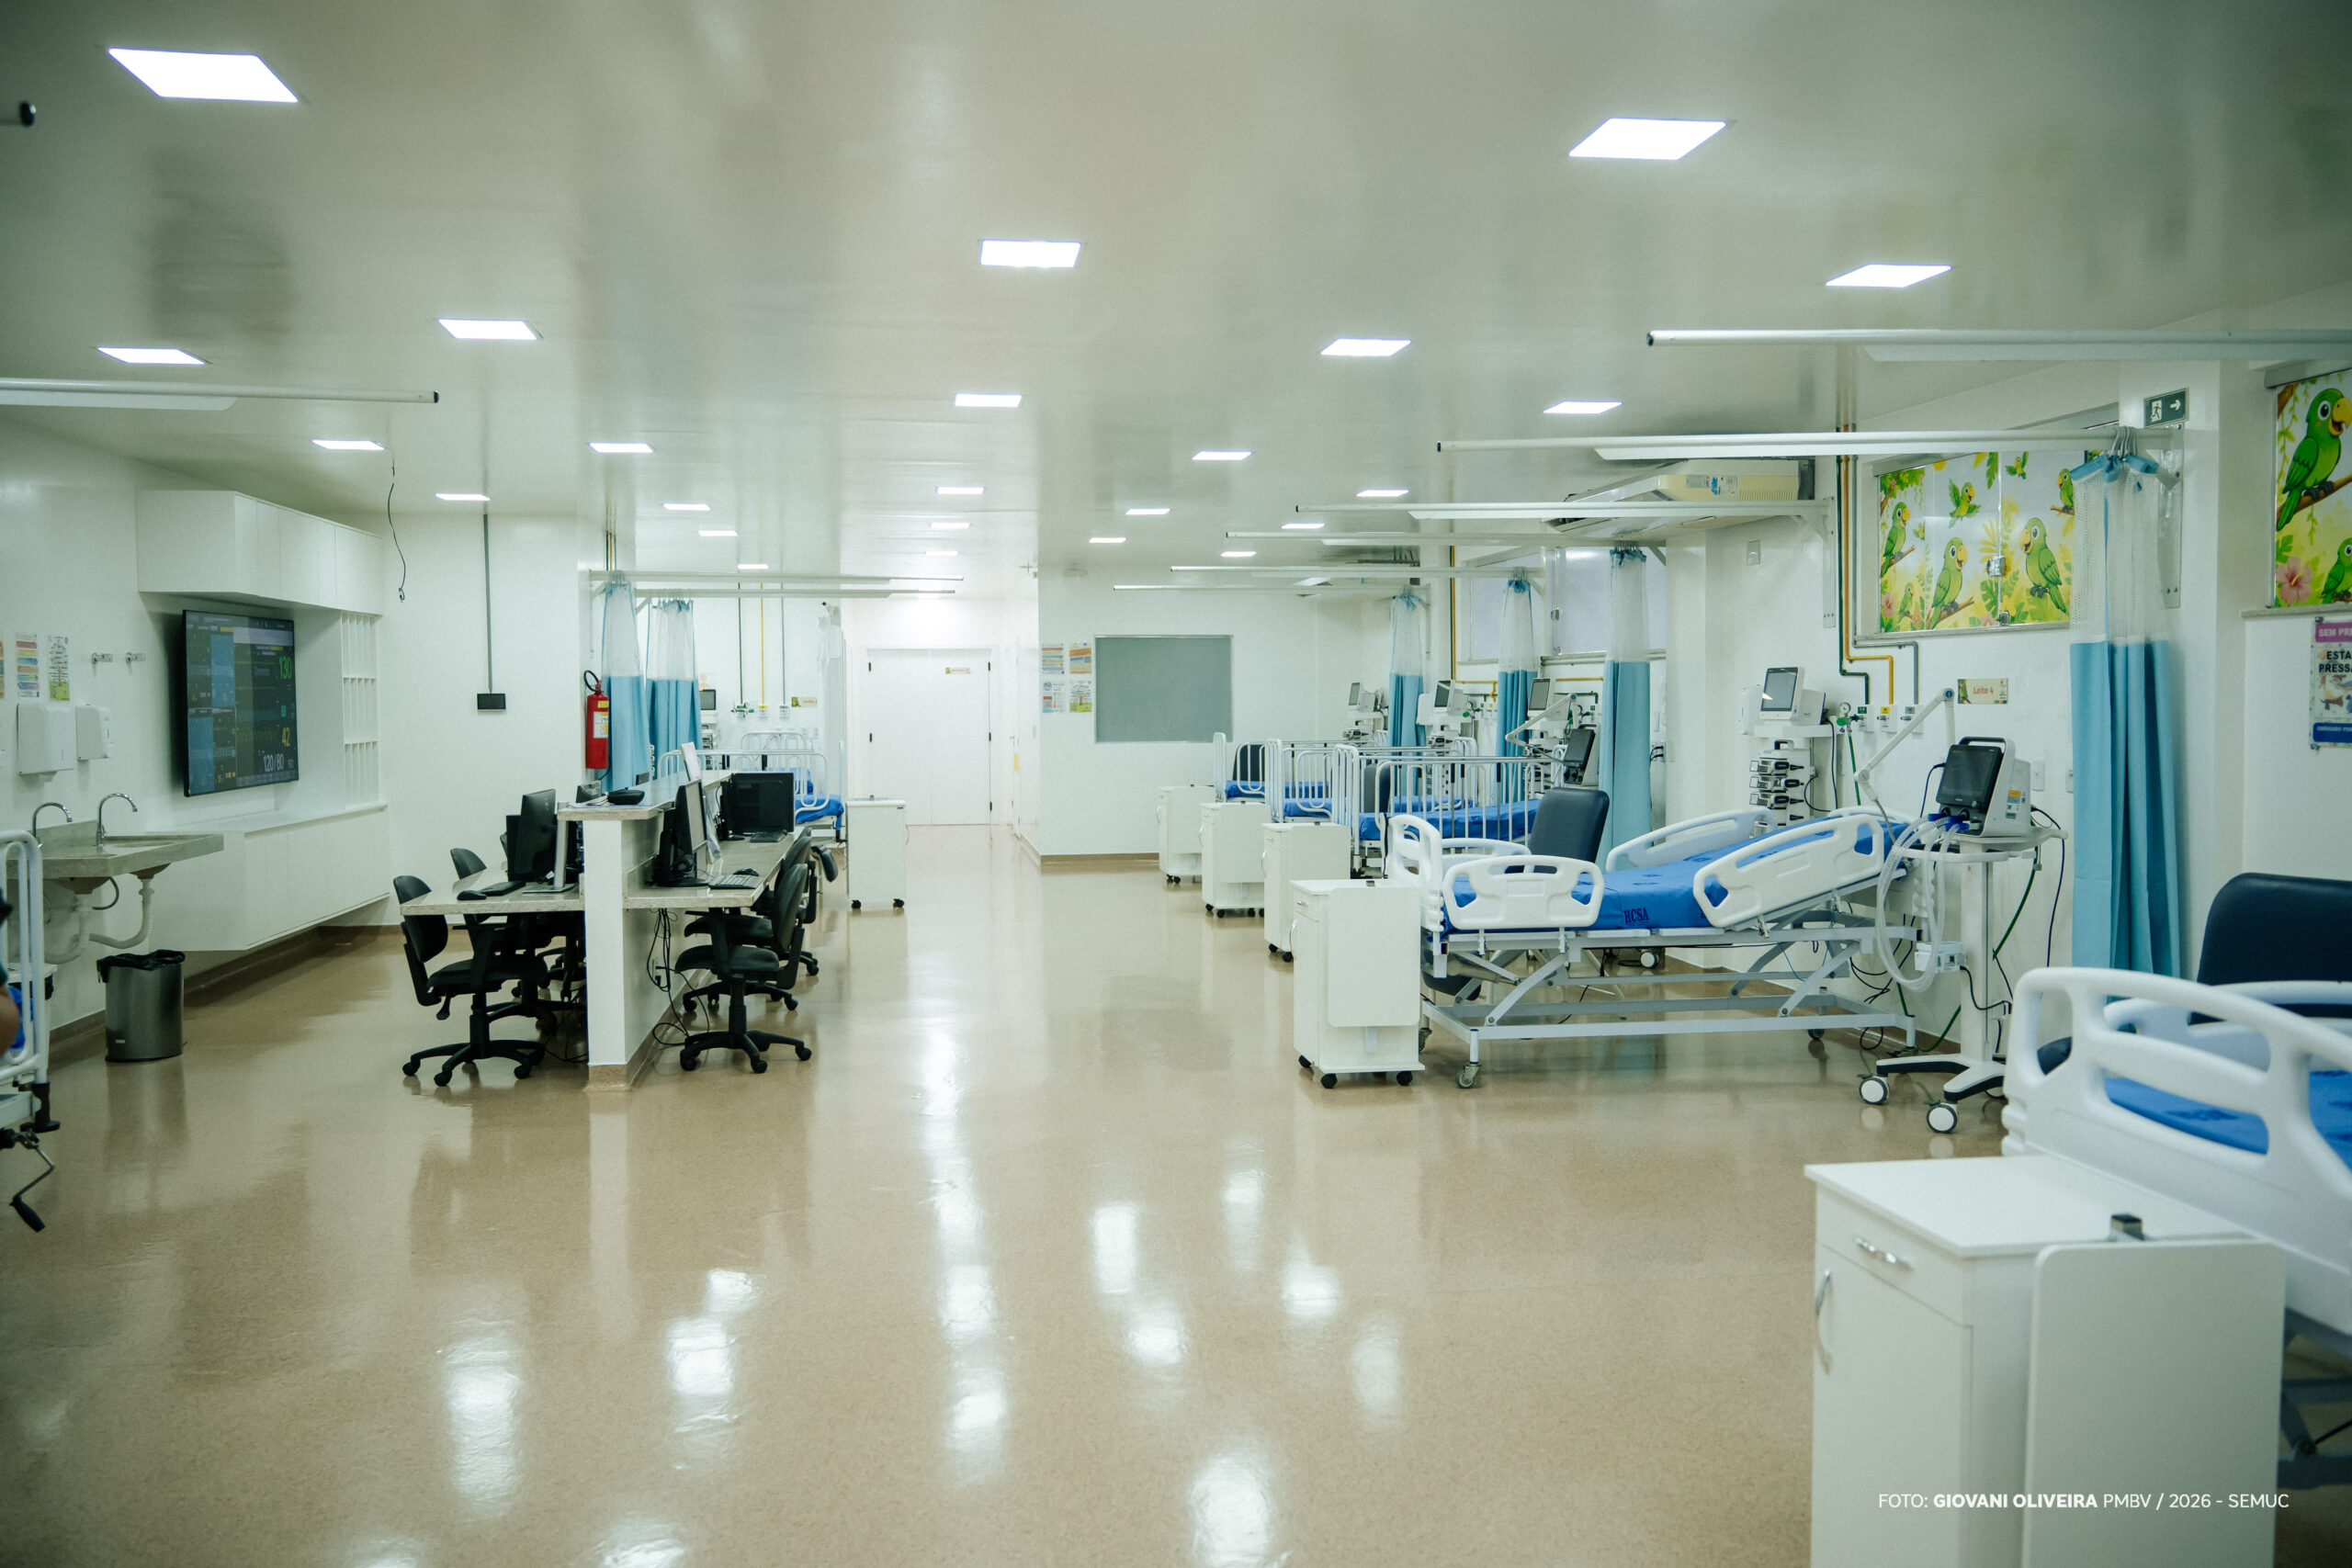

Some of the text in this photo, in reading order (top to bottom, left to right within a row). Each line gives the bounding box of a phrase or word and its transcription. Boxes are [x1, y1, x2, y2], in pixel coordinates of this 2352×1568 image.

[2318, 628, 2336, 637] SEM
[278, 655, 293, 680] 130
[2318, 662, 2352, 673] PRESS
[281, 727, 291, 747] 42
[1623, 907, 1650, 923] HCSA
